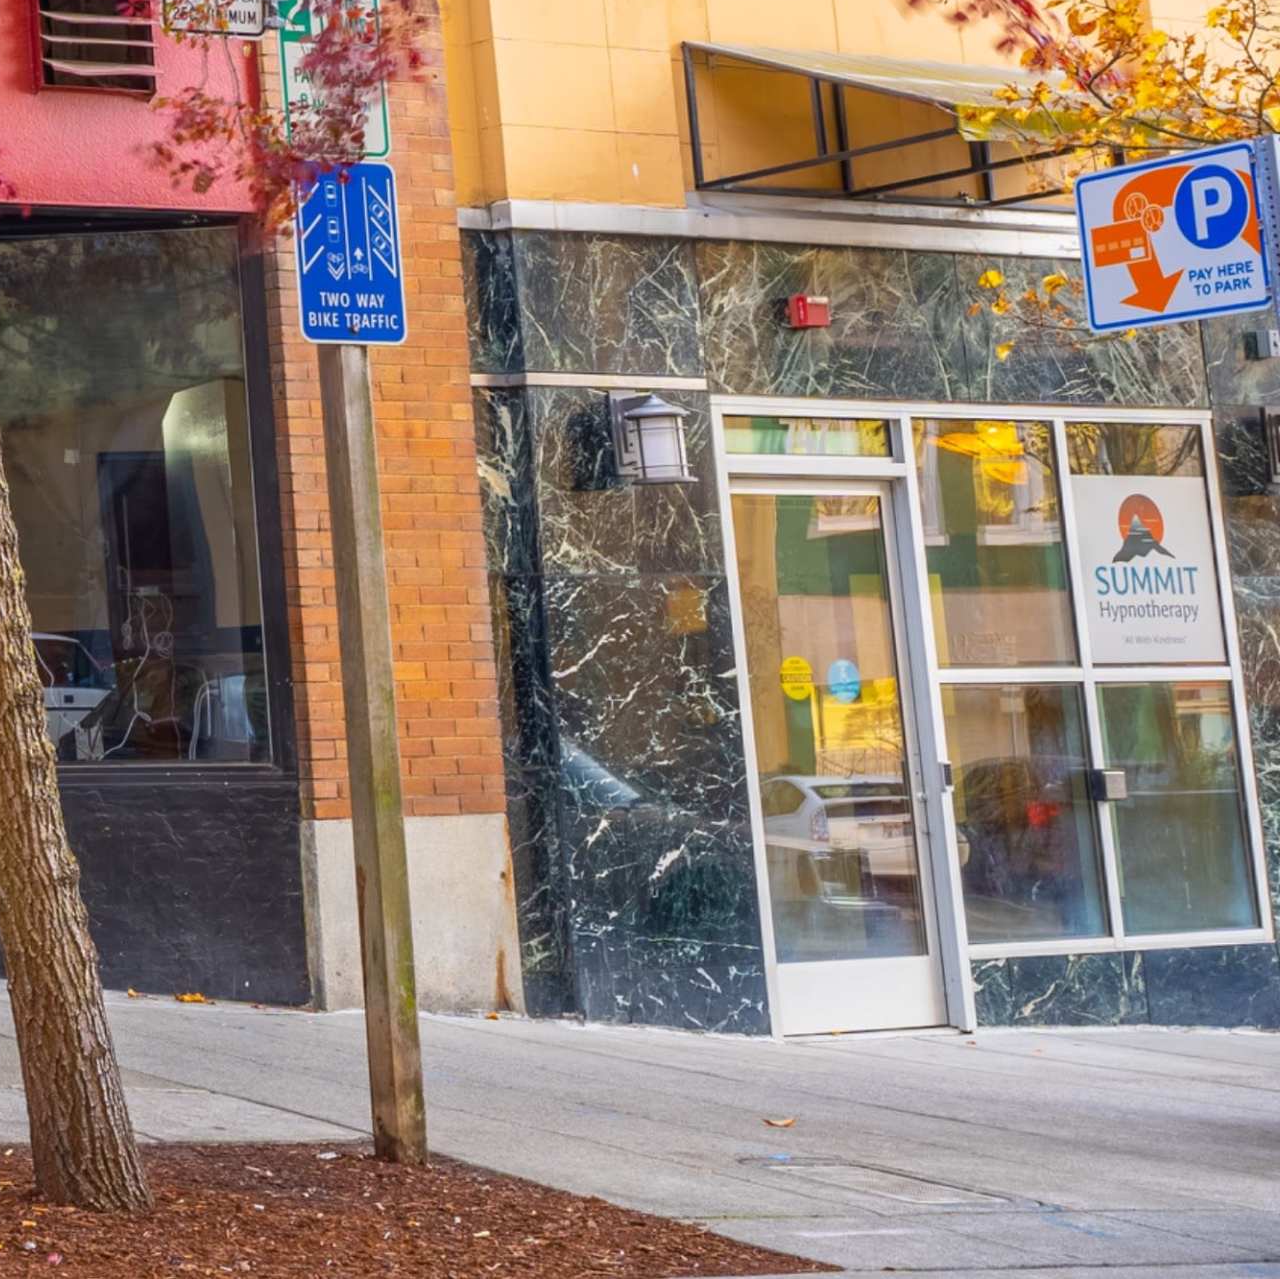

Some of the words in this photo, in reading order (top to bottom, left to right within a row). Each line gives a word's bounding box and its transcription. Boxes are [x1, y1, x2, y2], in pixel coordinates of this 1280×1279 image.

[1191, 175, 1233, 241] P
[1188, 266, 1213, 282] PAY
[1217, 260, 1254, 277] HERE
[1193, 283, 1211, 297] TO
[1215, 277, 1253, 294] PARK
[319, 291, 350, 308] TWO
[356, 293, 385, 309] WAY
[308, 311, 340, 327] BIKE
[344, 313, 400, 330] TRAFFIC
[1095, 566, 1198, 596] SUMMIT
[1099, 600, 1200, 623] Hypnotherapy
